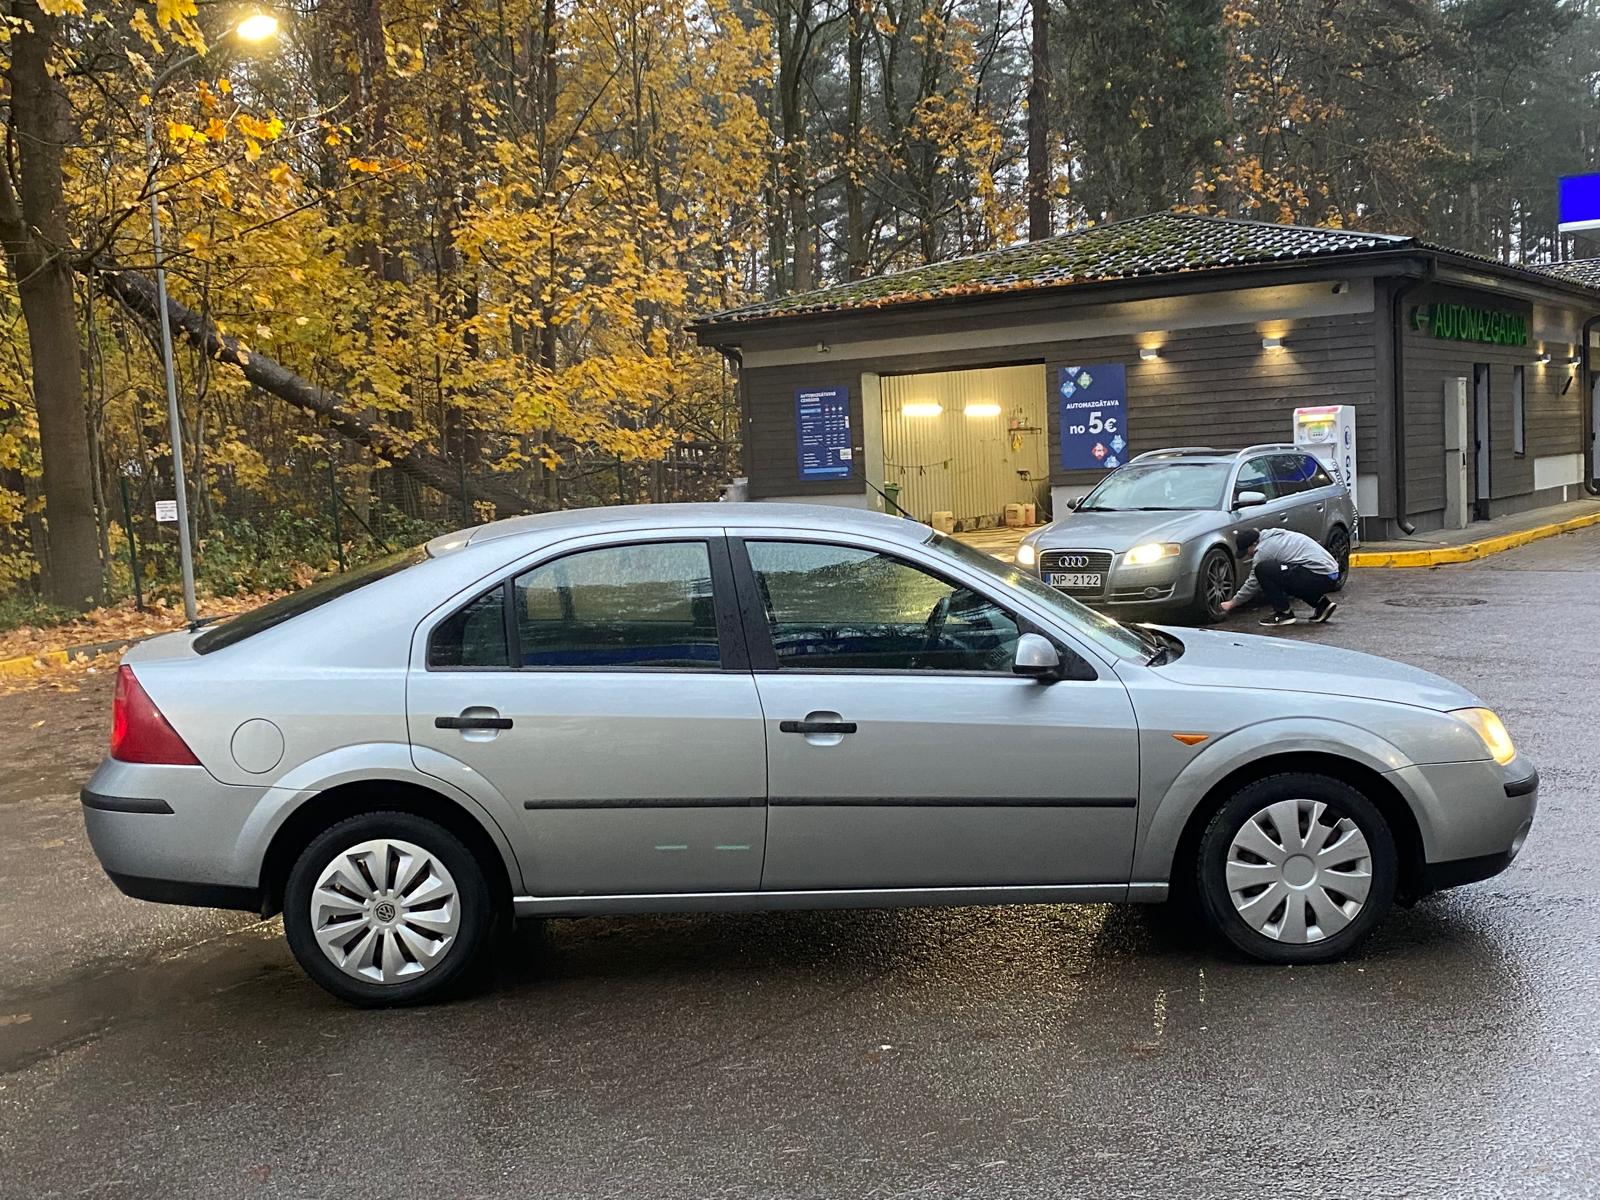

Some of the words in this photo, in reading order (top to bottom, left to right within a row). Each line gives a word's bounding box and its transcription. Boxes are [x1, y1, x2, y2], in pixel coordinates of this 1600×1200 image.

[1066, 400, 1119, 409] AUTOMAZGĀTAVA
[1069, 425, 1085, 434] no
[1052, 574, 1099, 585] NP-2122
